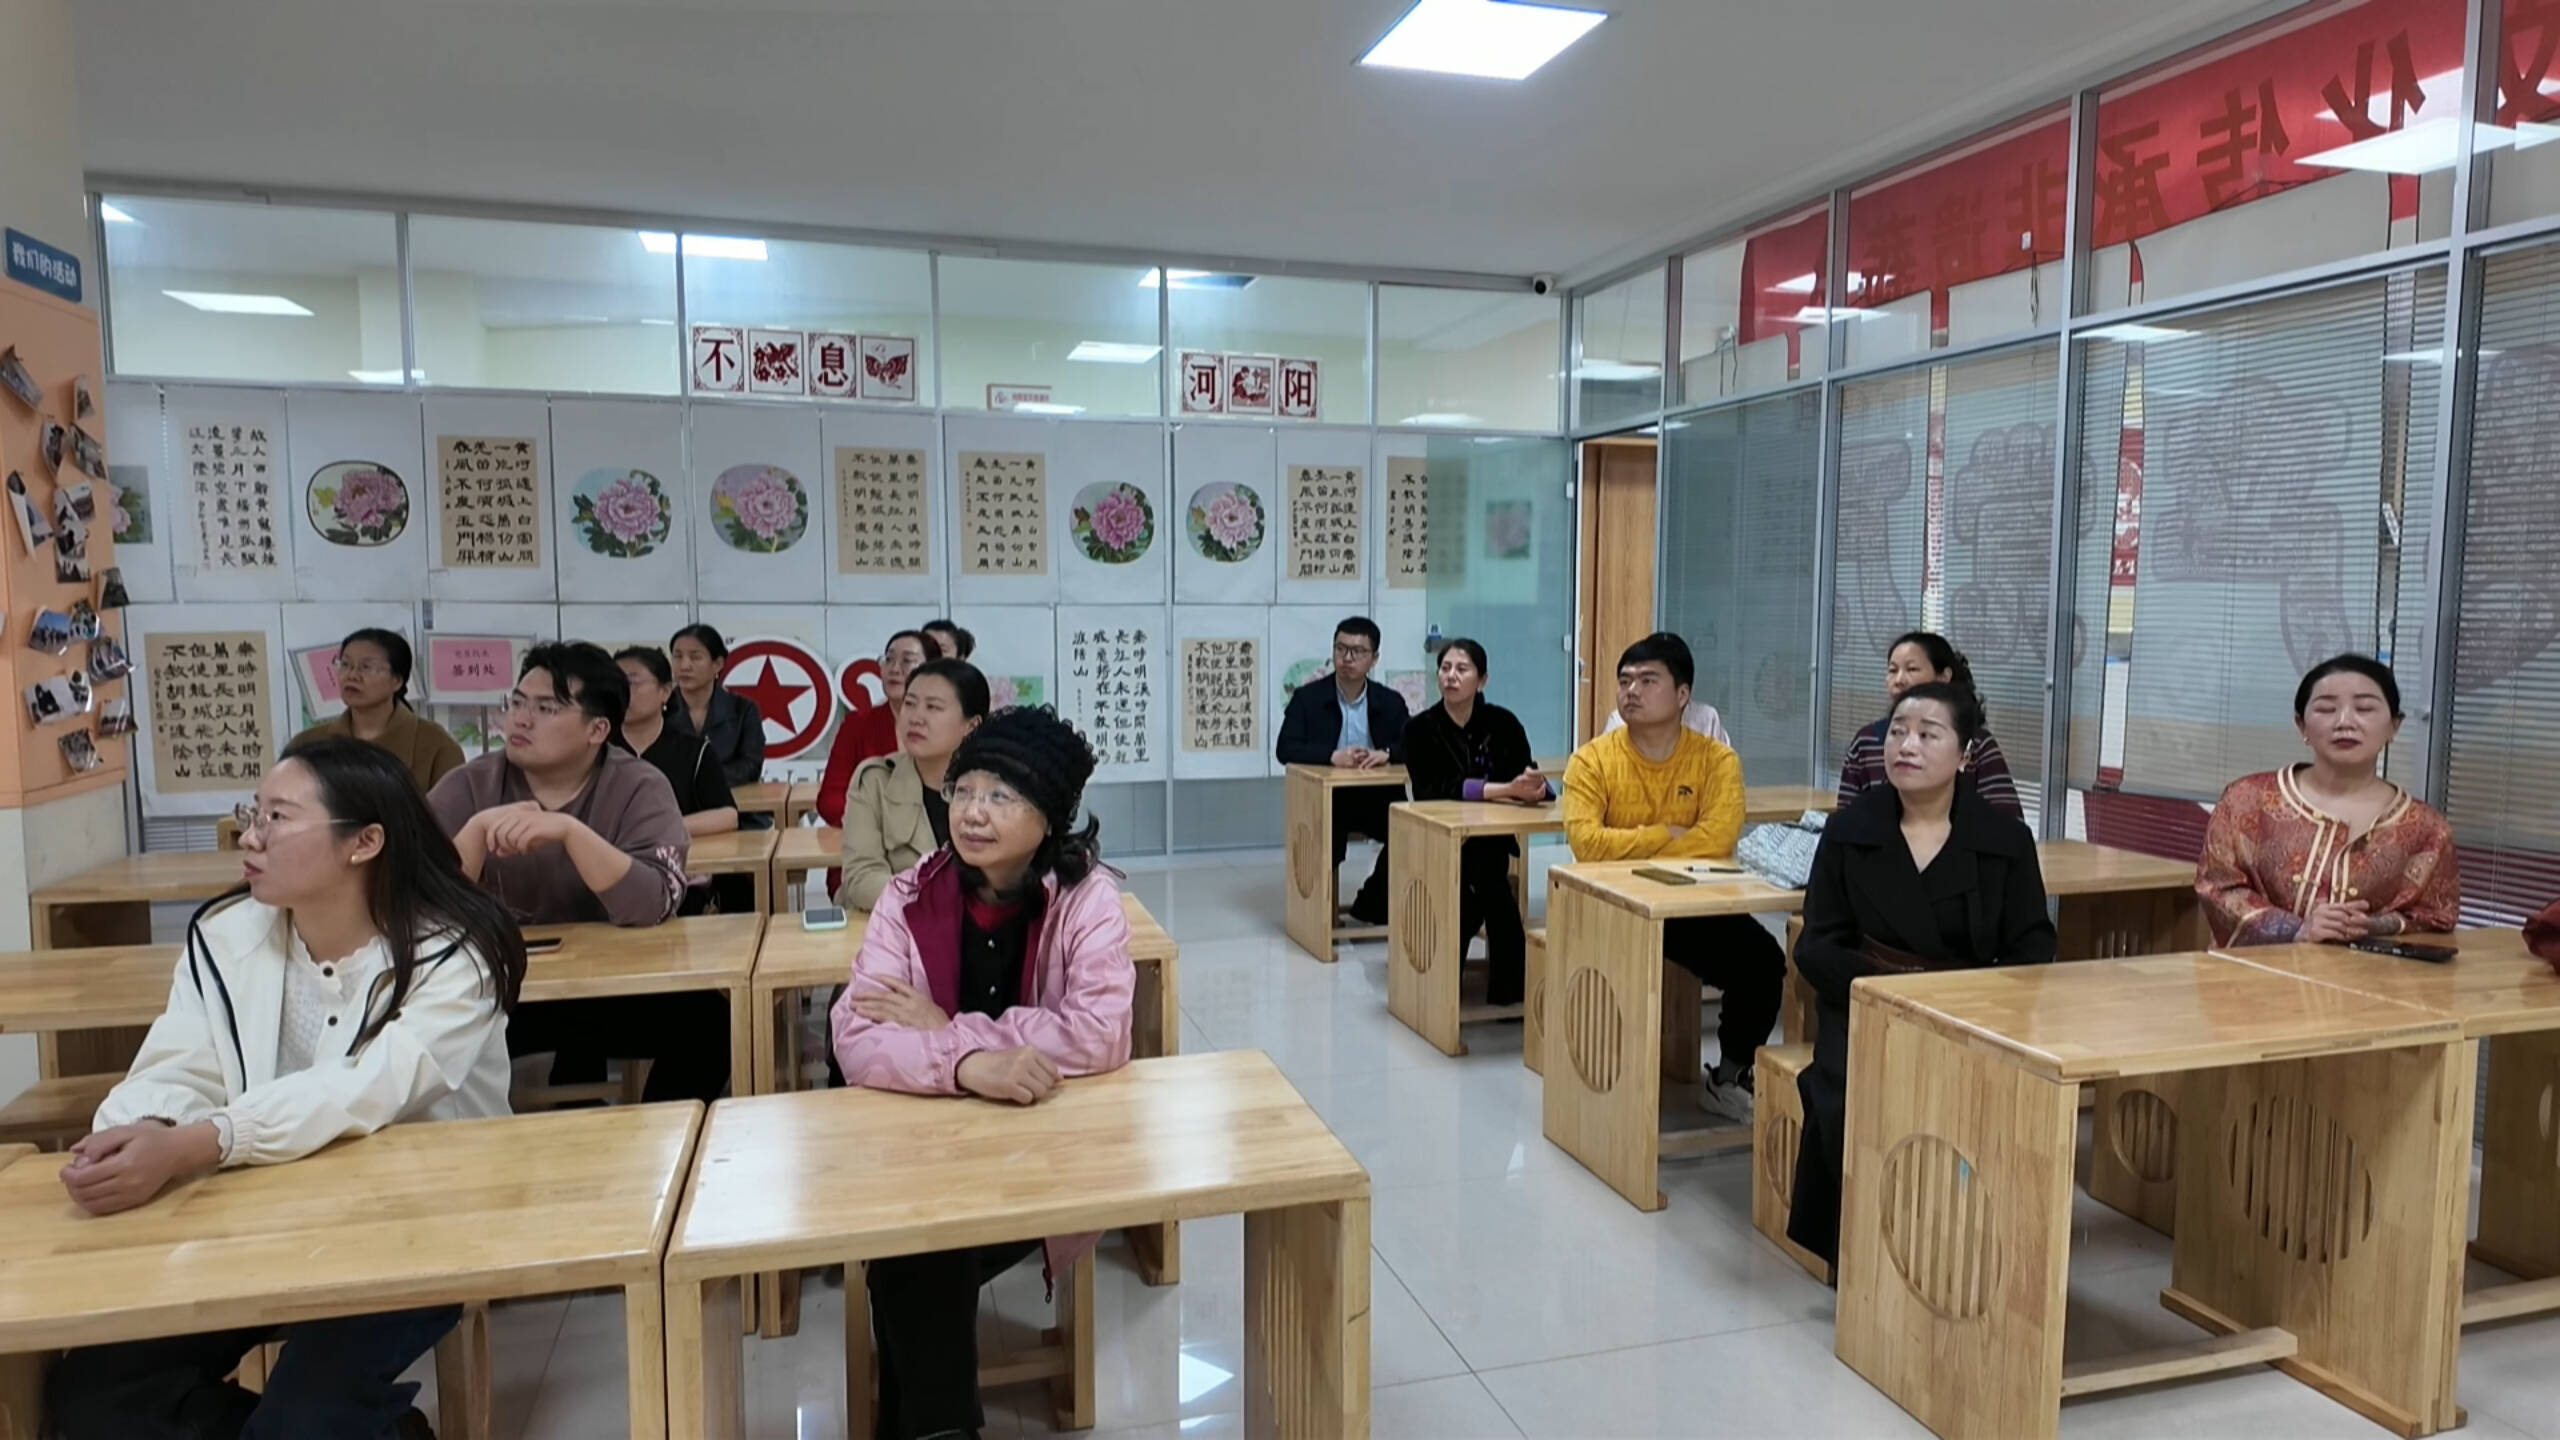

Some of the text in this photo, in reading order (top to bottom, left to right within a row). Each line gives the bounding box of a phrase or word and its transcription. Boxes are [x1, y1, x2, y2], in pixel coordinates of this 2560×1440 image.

[12, 240, 77, 288] 我们的活动
[702, 339, 848, 387] 不 息
[1190, 364, 1312, 408] 河 阳
